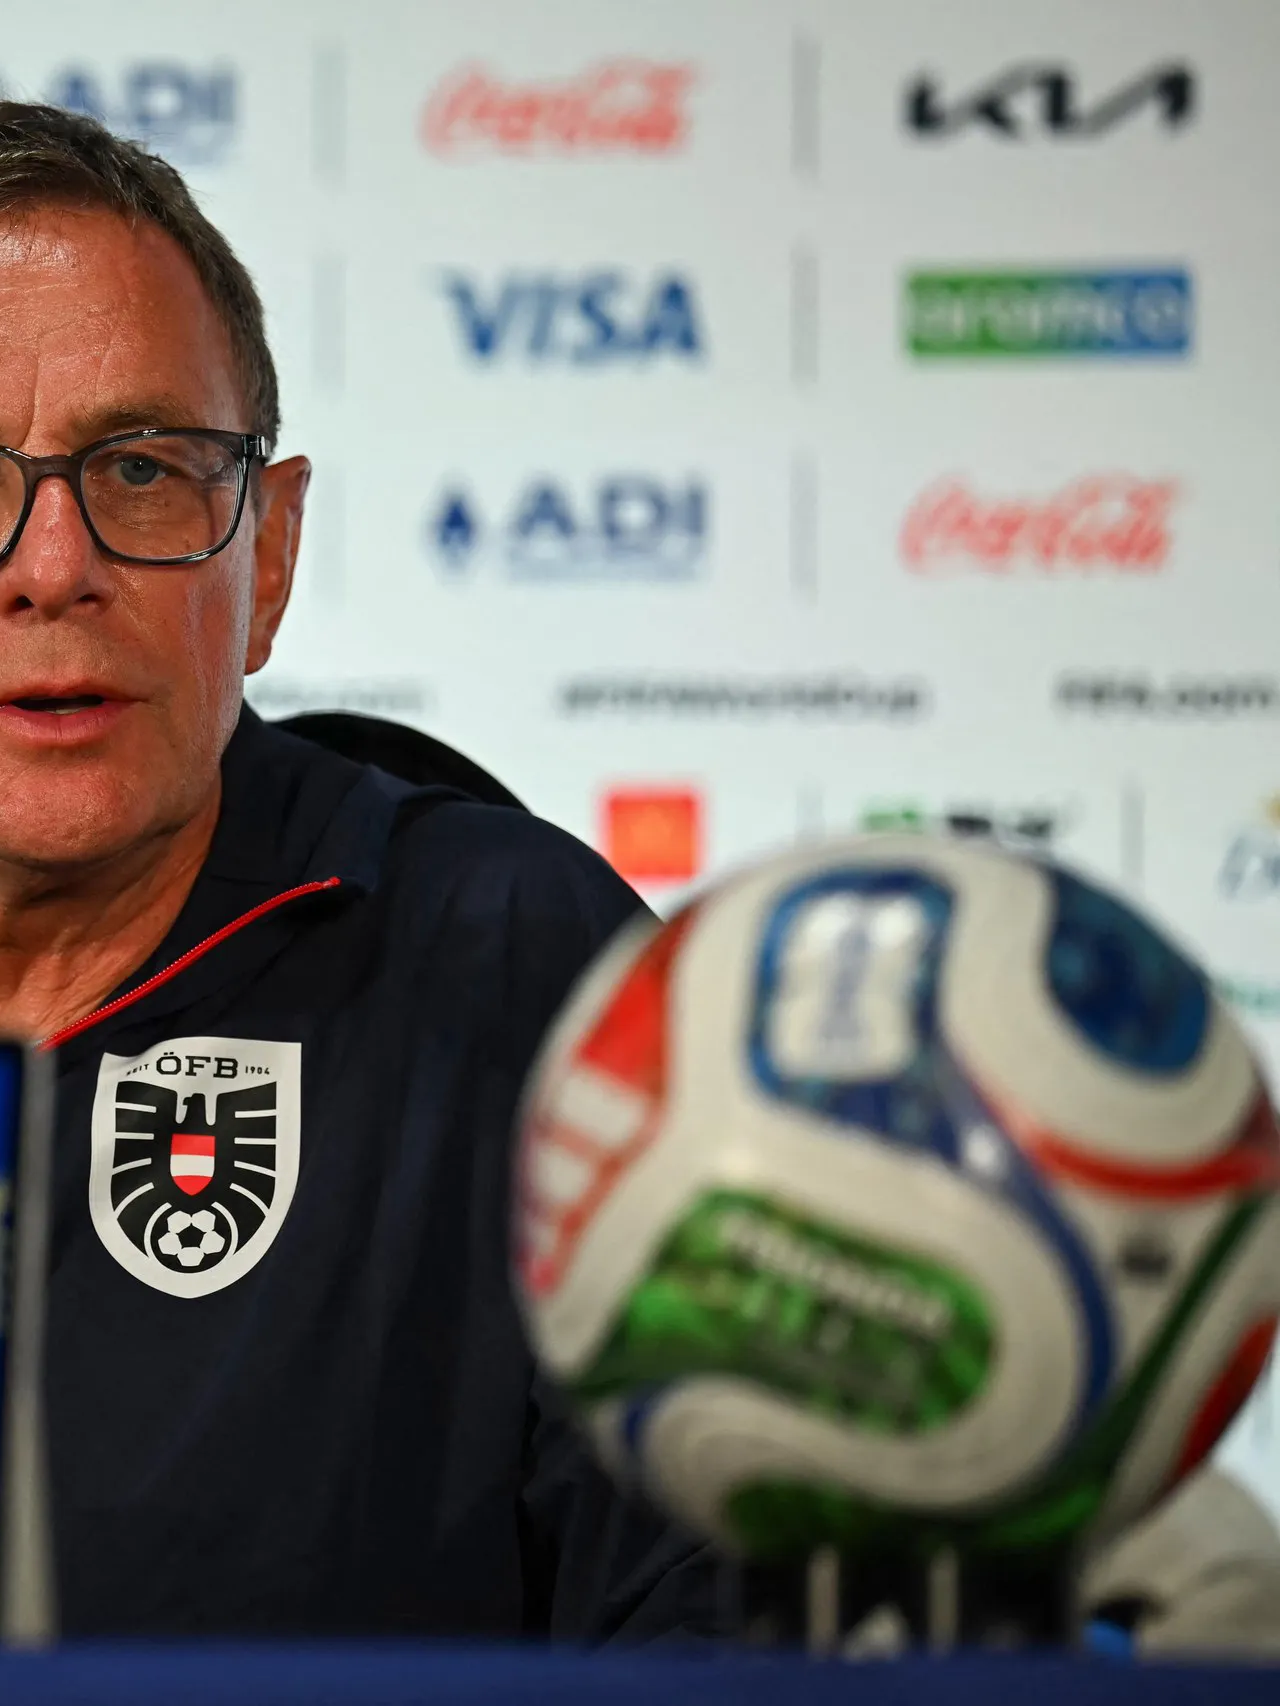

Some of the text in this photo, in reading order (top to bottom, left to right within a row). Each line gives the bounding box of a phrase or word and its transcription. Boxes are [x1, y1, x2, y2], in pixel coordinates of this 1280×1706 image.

[421, 61, 694, 155] Coca-Cola
[445, 271, 704, 366] VISA
[512, 477, 709, 546] ADI
[899, 478, 1177, 572] Coca-Cola
[156, 1051, 239, 1079] ÖFB
[245, 1065, 270, 1075] 1904
